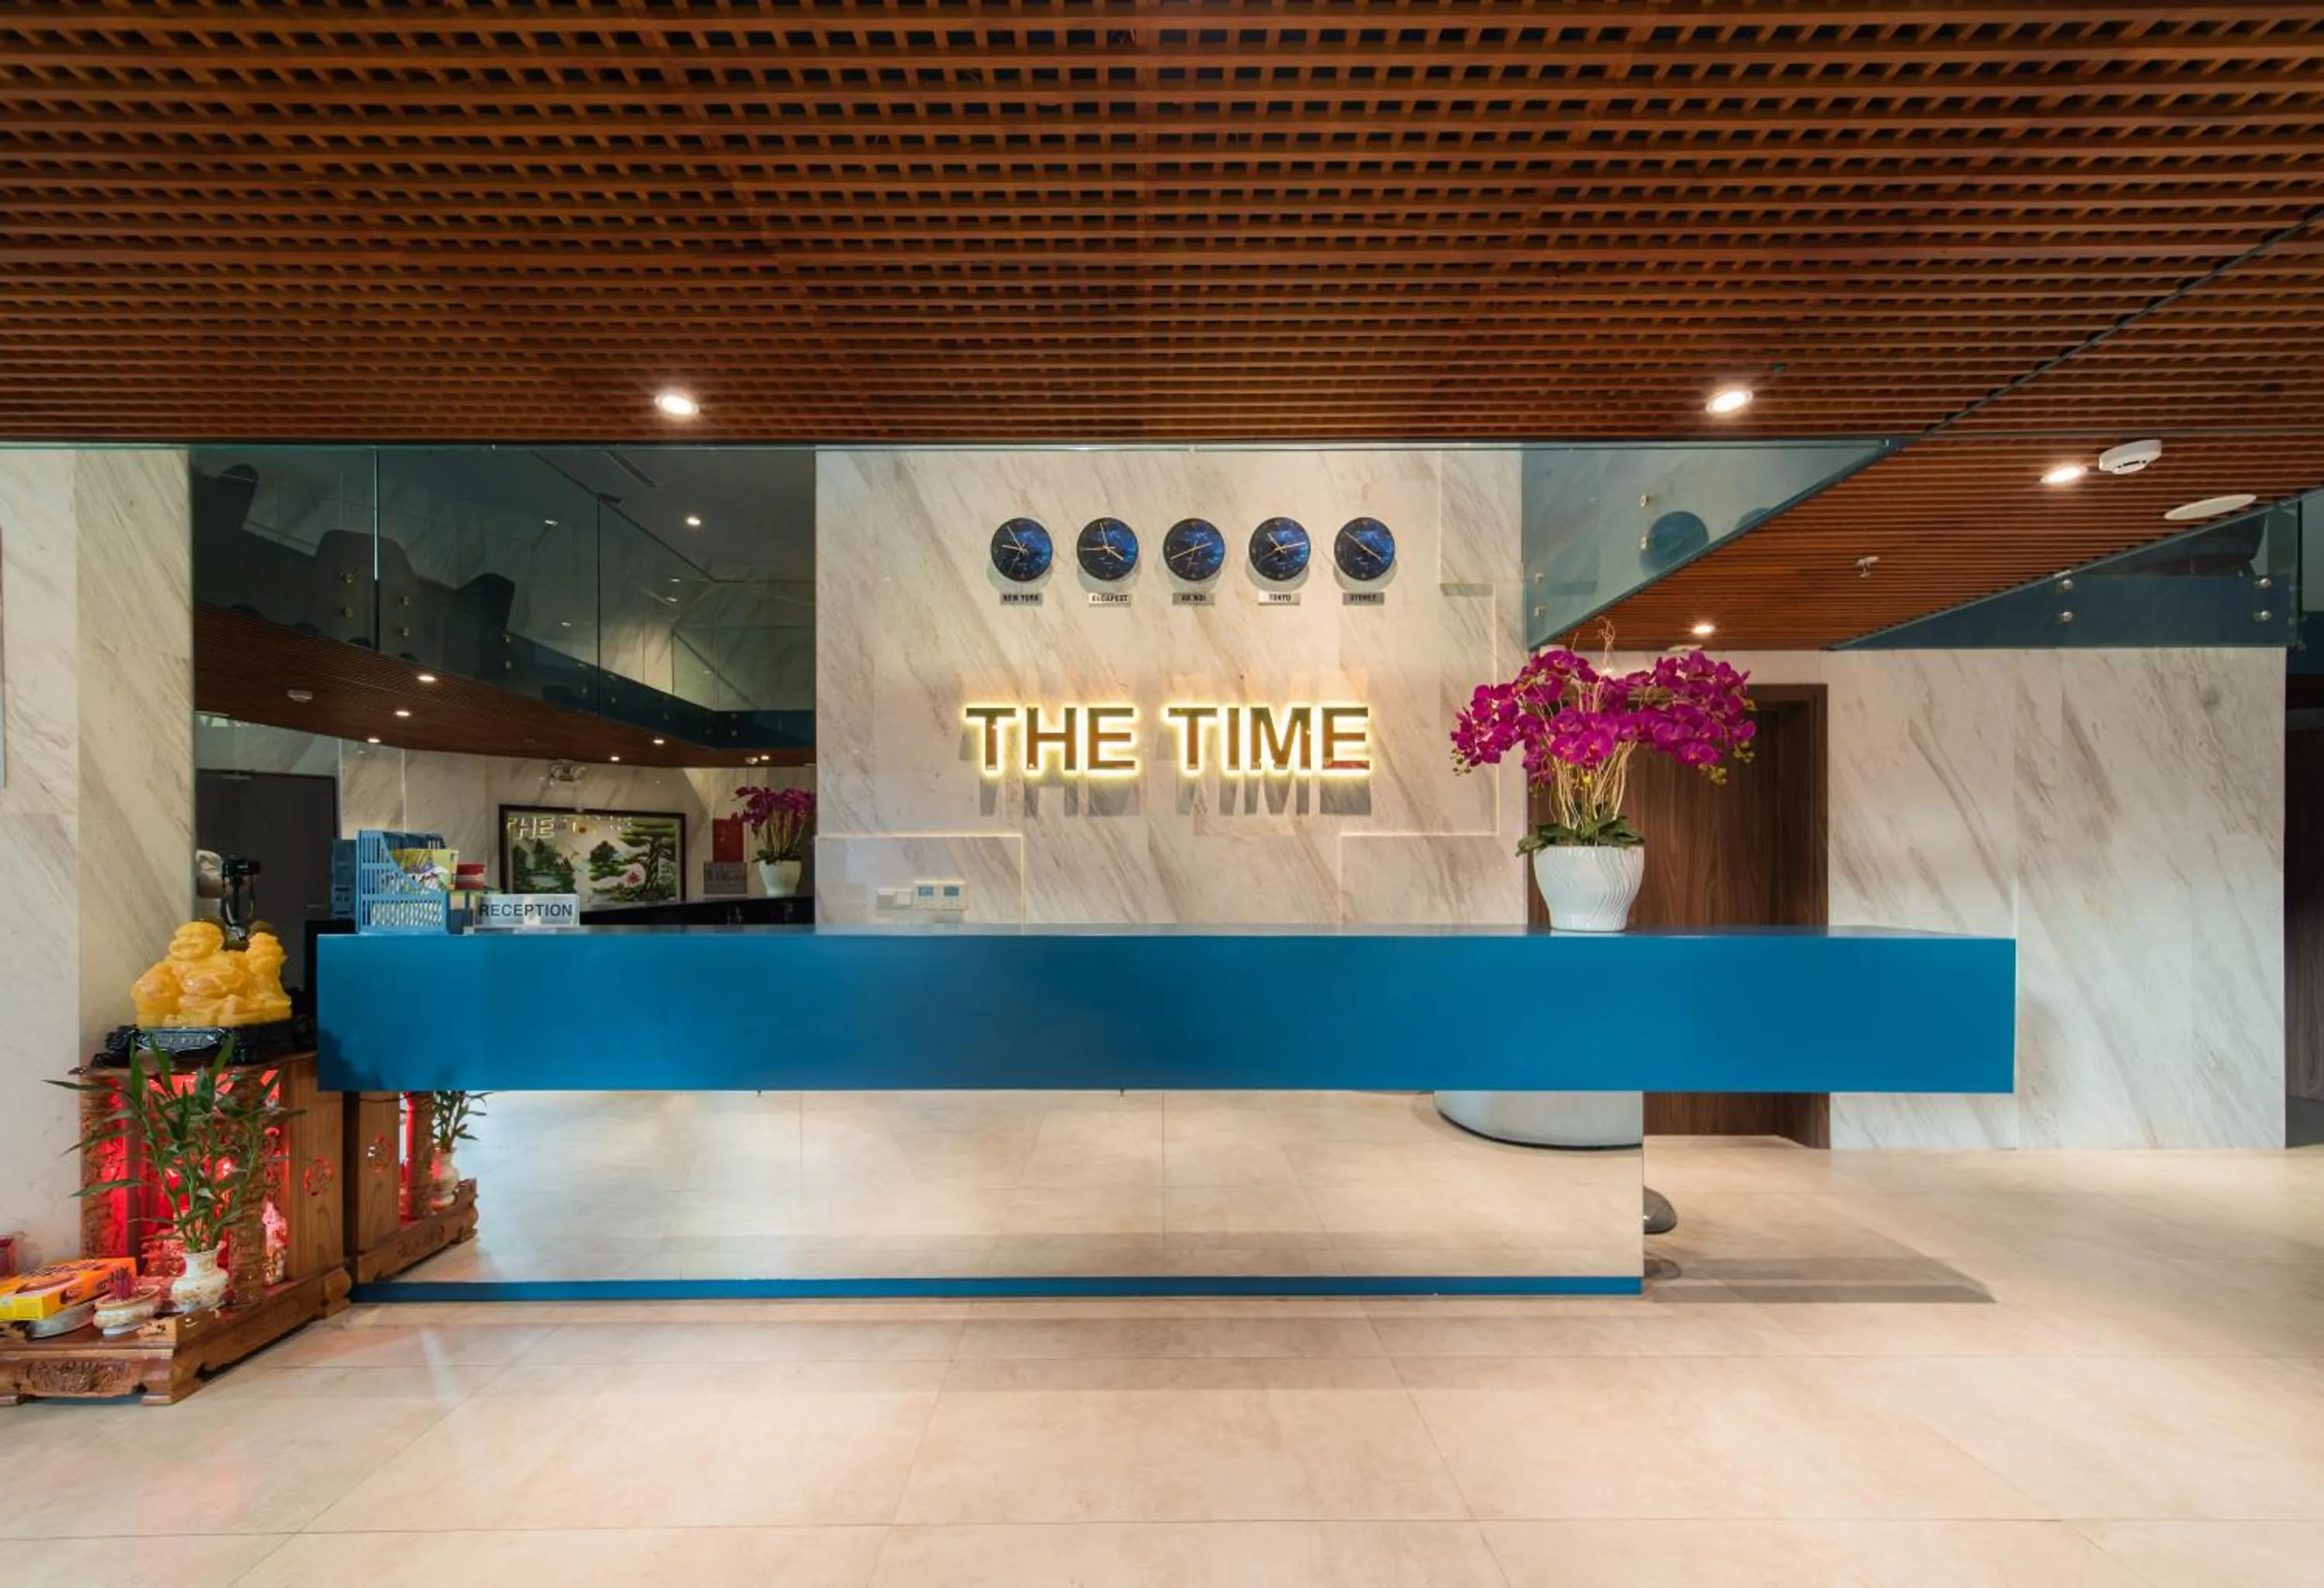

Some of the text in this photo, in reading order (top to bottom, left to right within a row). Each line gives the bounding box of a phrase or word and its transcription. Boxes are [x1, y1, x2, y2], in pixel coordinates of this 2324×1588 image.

[1269, 593, 1291, 602] TOKYO
[965, 706, 1370, 770] THE TIME
[478, 903, 573, 917] RECEPTION
